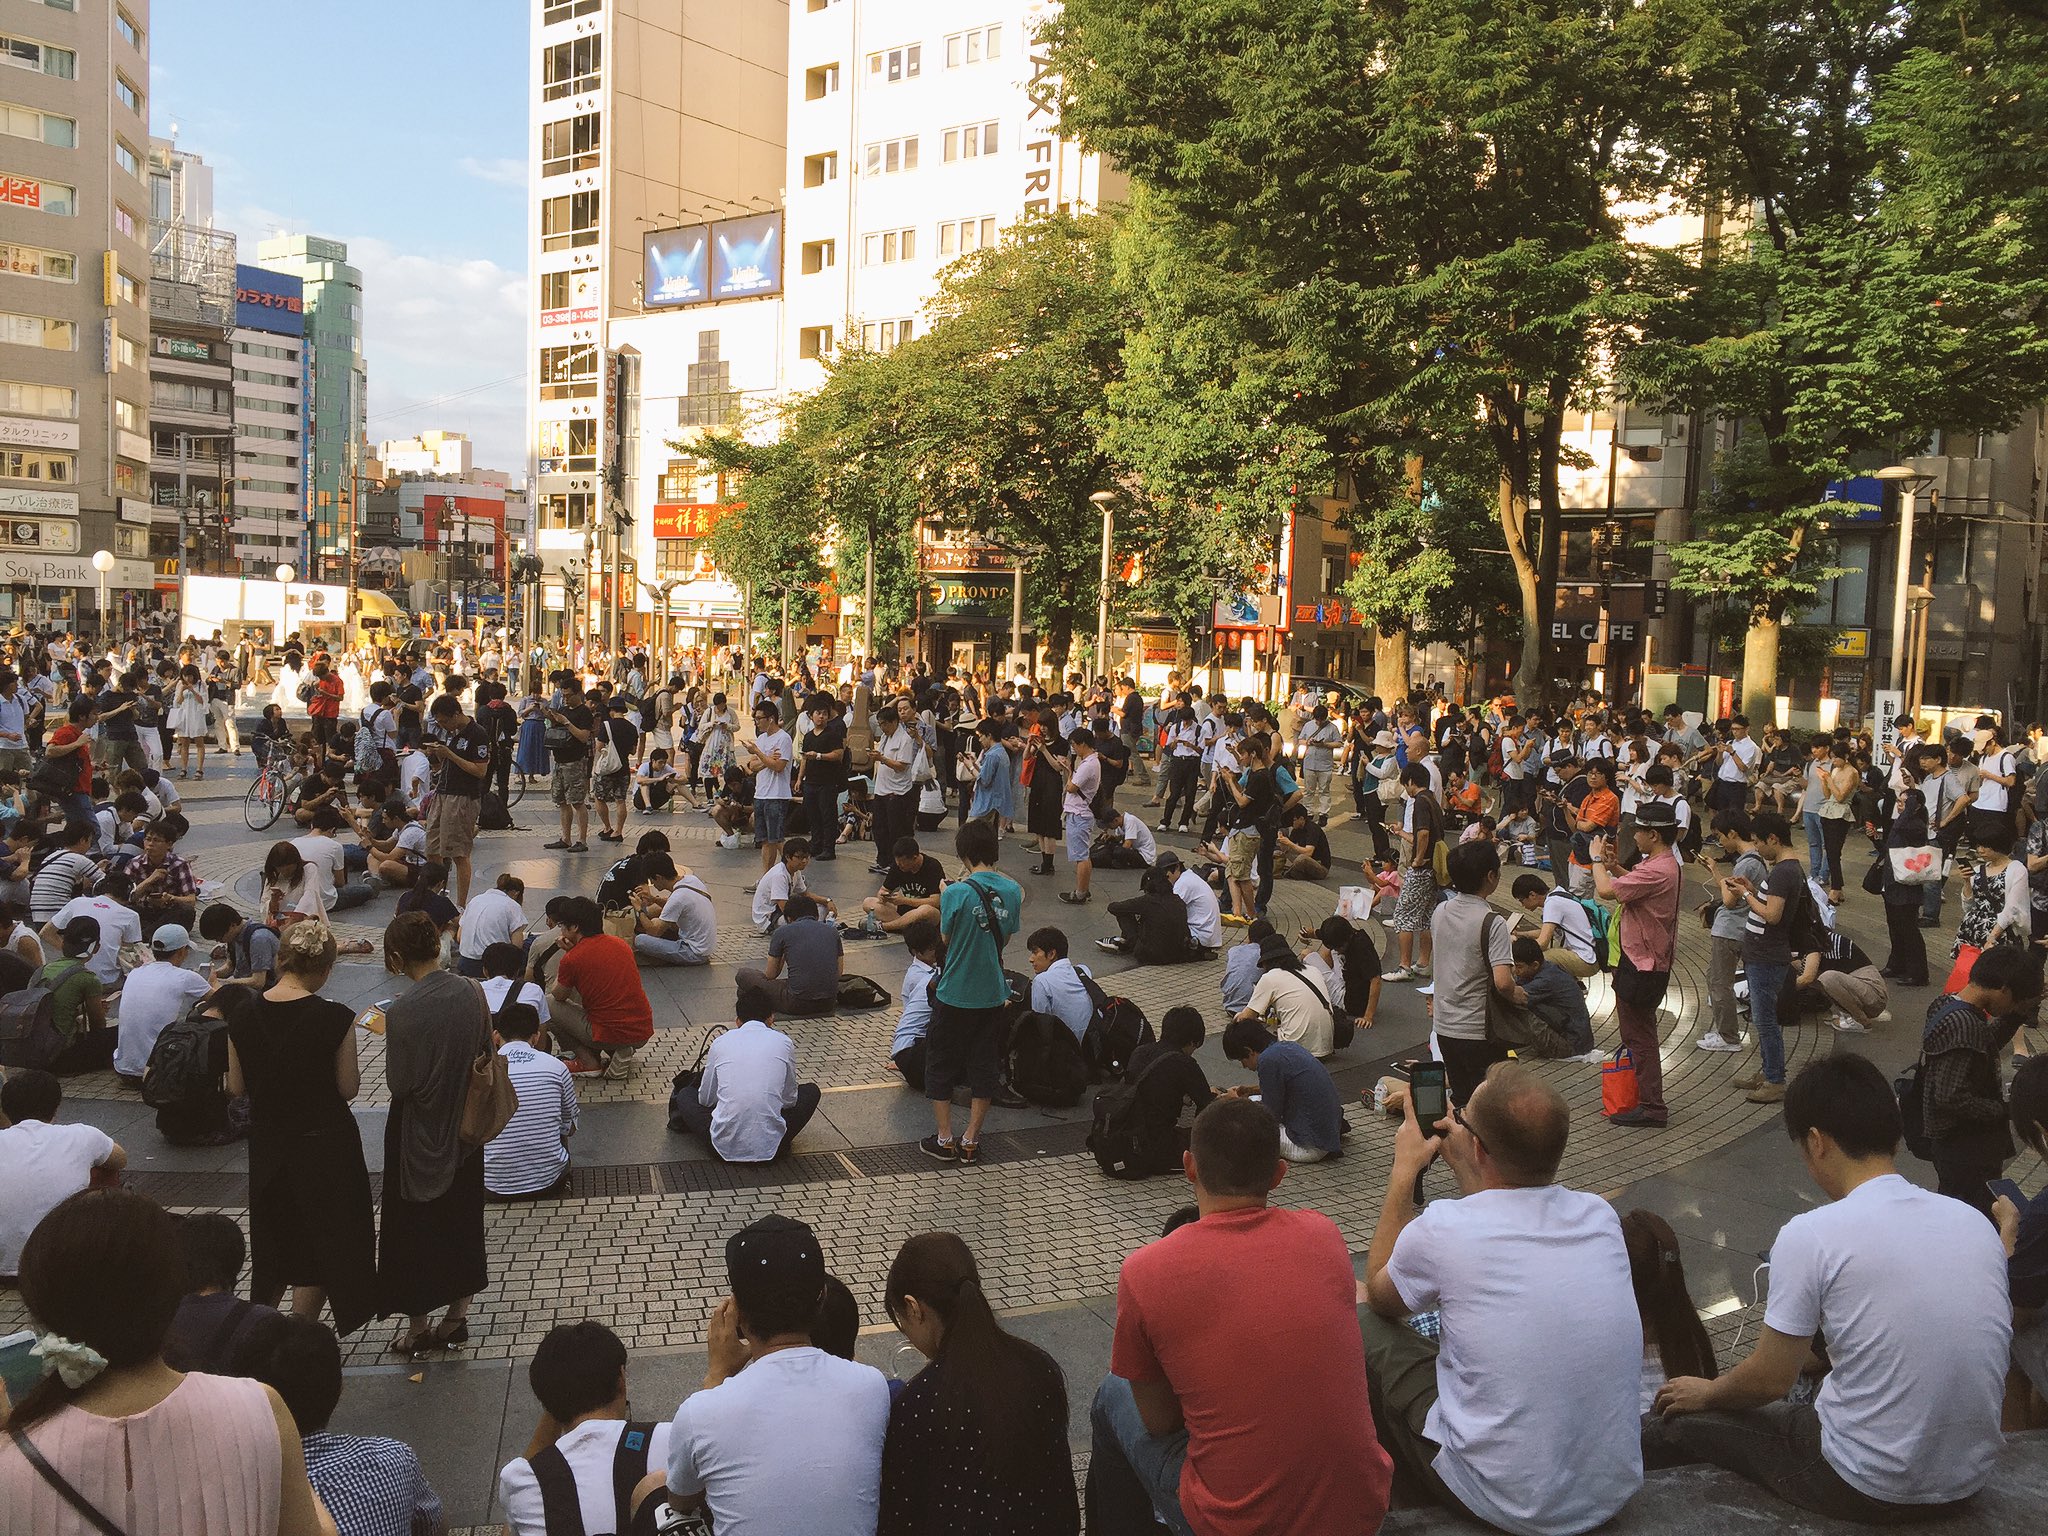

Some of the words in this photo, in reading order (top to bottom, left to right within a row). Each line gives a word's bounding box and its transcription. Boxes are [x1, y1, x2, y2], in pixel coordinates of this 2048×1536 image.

[236, 287, 302, 313] カラオケ館
[5, 560, 88, 580] SoBank
